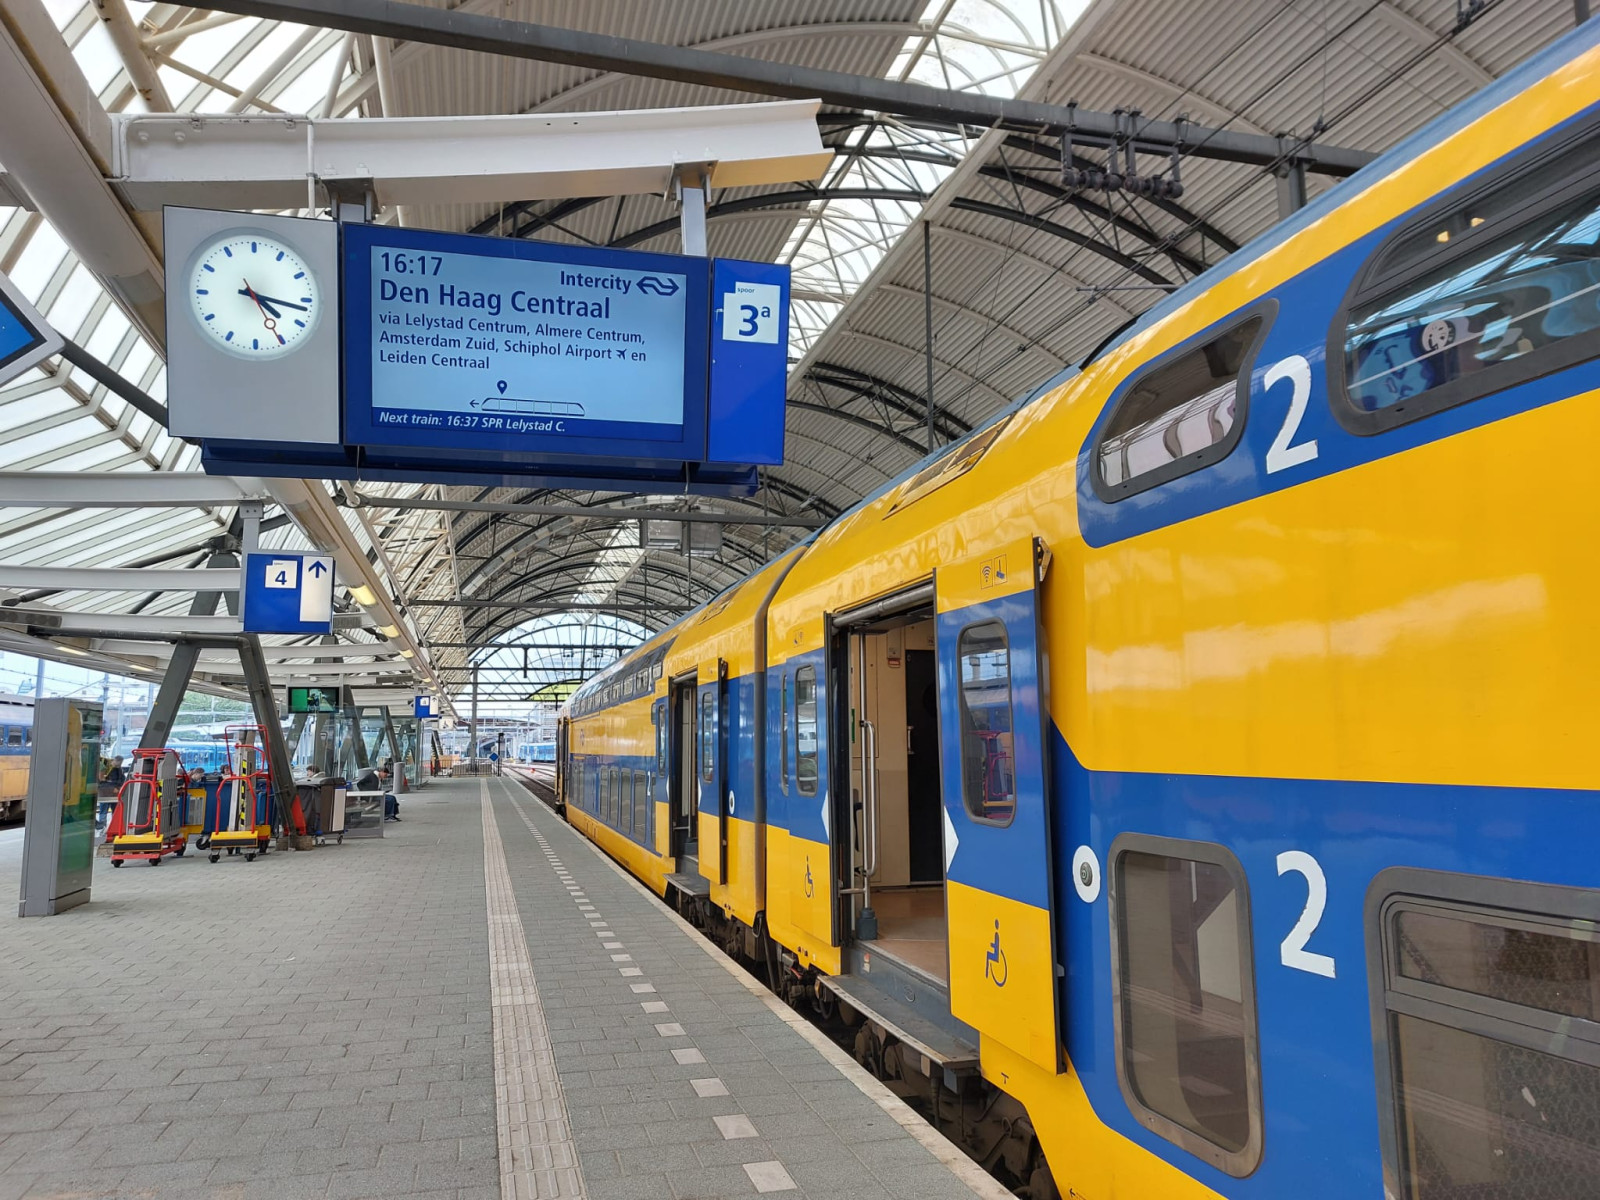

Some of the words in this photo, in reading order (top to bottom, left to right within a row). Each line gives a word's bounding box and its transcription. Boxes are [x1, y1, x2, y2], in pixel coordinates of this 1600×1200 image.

[380, 252, 443, 276] 16:17
[561, 271, 631, 294] Intercity
[380, 279, 429, 304] Den
[440, 284, 501, 315] Haag
[511, 291, 610, 318] Centraal
[380, 313, 400, 324] via
[406, 313, 463, 330] Lelystad
[468, 318, 530, 336] Centrum,
[536, 324, 582, 338] Almere
[587, 328, 645, 344] Centrum,
[380, 331, 461, 348] Amsterdam
[465, 337, 499, 353] Zuid,
[504, 340, 561, 357] Schiphol
[566, 345, 612, 361] Airport
[631, 351, 646, 361] en
[380, 350, 426, 365] Leiden
[432, 354, 489, 369] Centraal
[380, 412, 407, 424] Next
[411, 413, 442, 426] train:
[447, 415, 478, 427] 16:37
[481, 417, 503, 429] SPR
[506, 419, 552, 432] Lelystad
[556, 421, 565, 431] C.
[1264, 355, 1318, 474] 2
[275, 571, 287, 585] 4
[1276, 850, 1336, 979] 2
